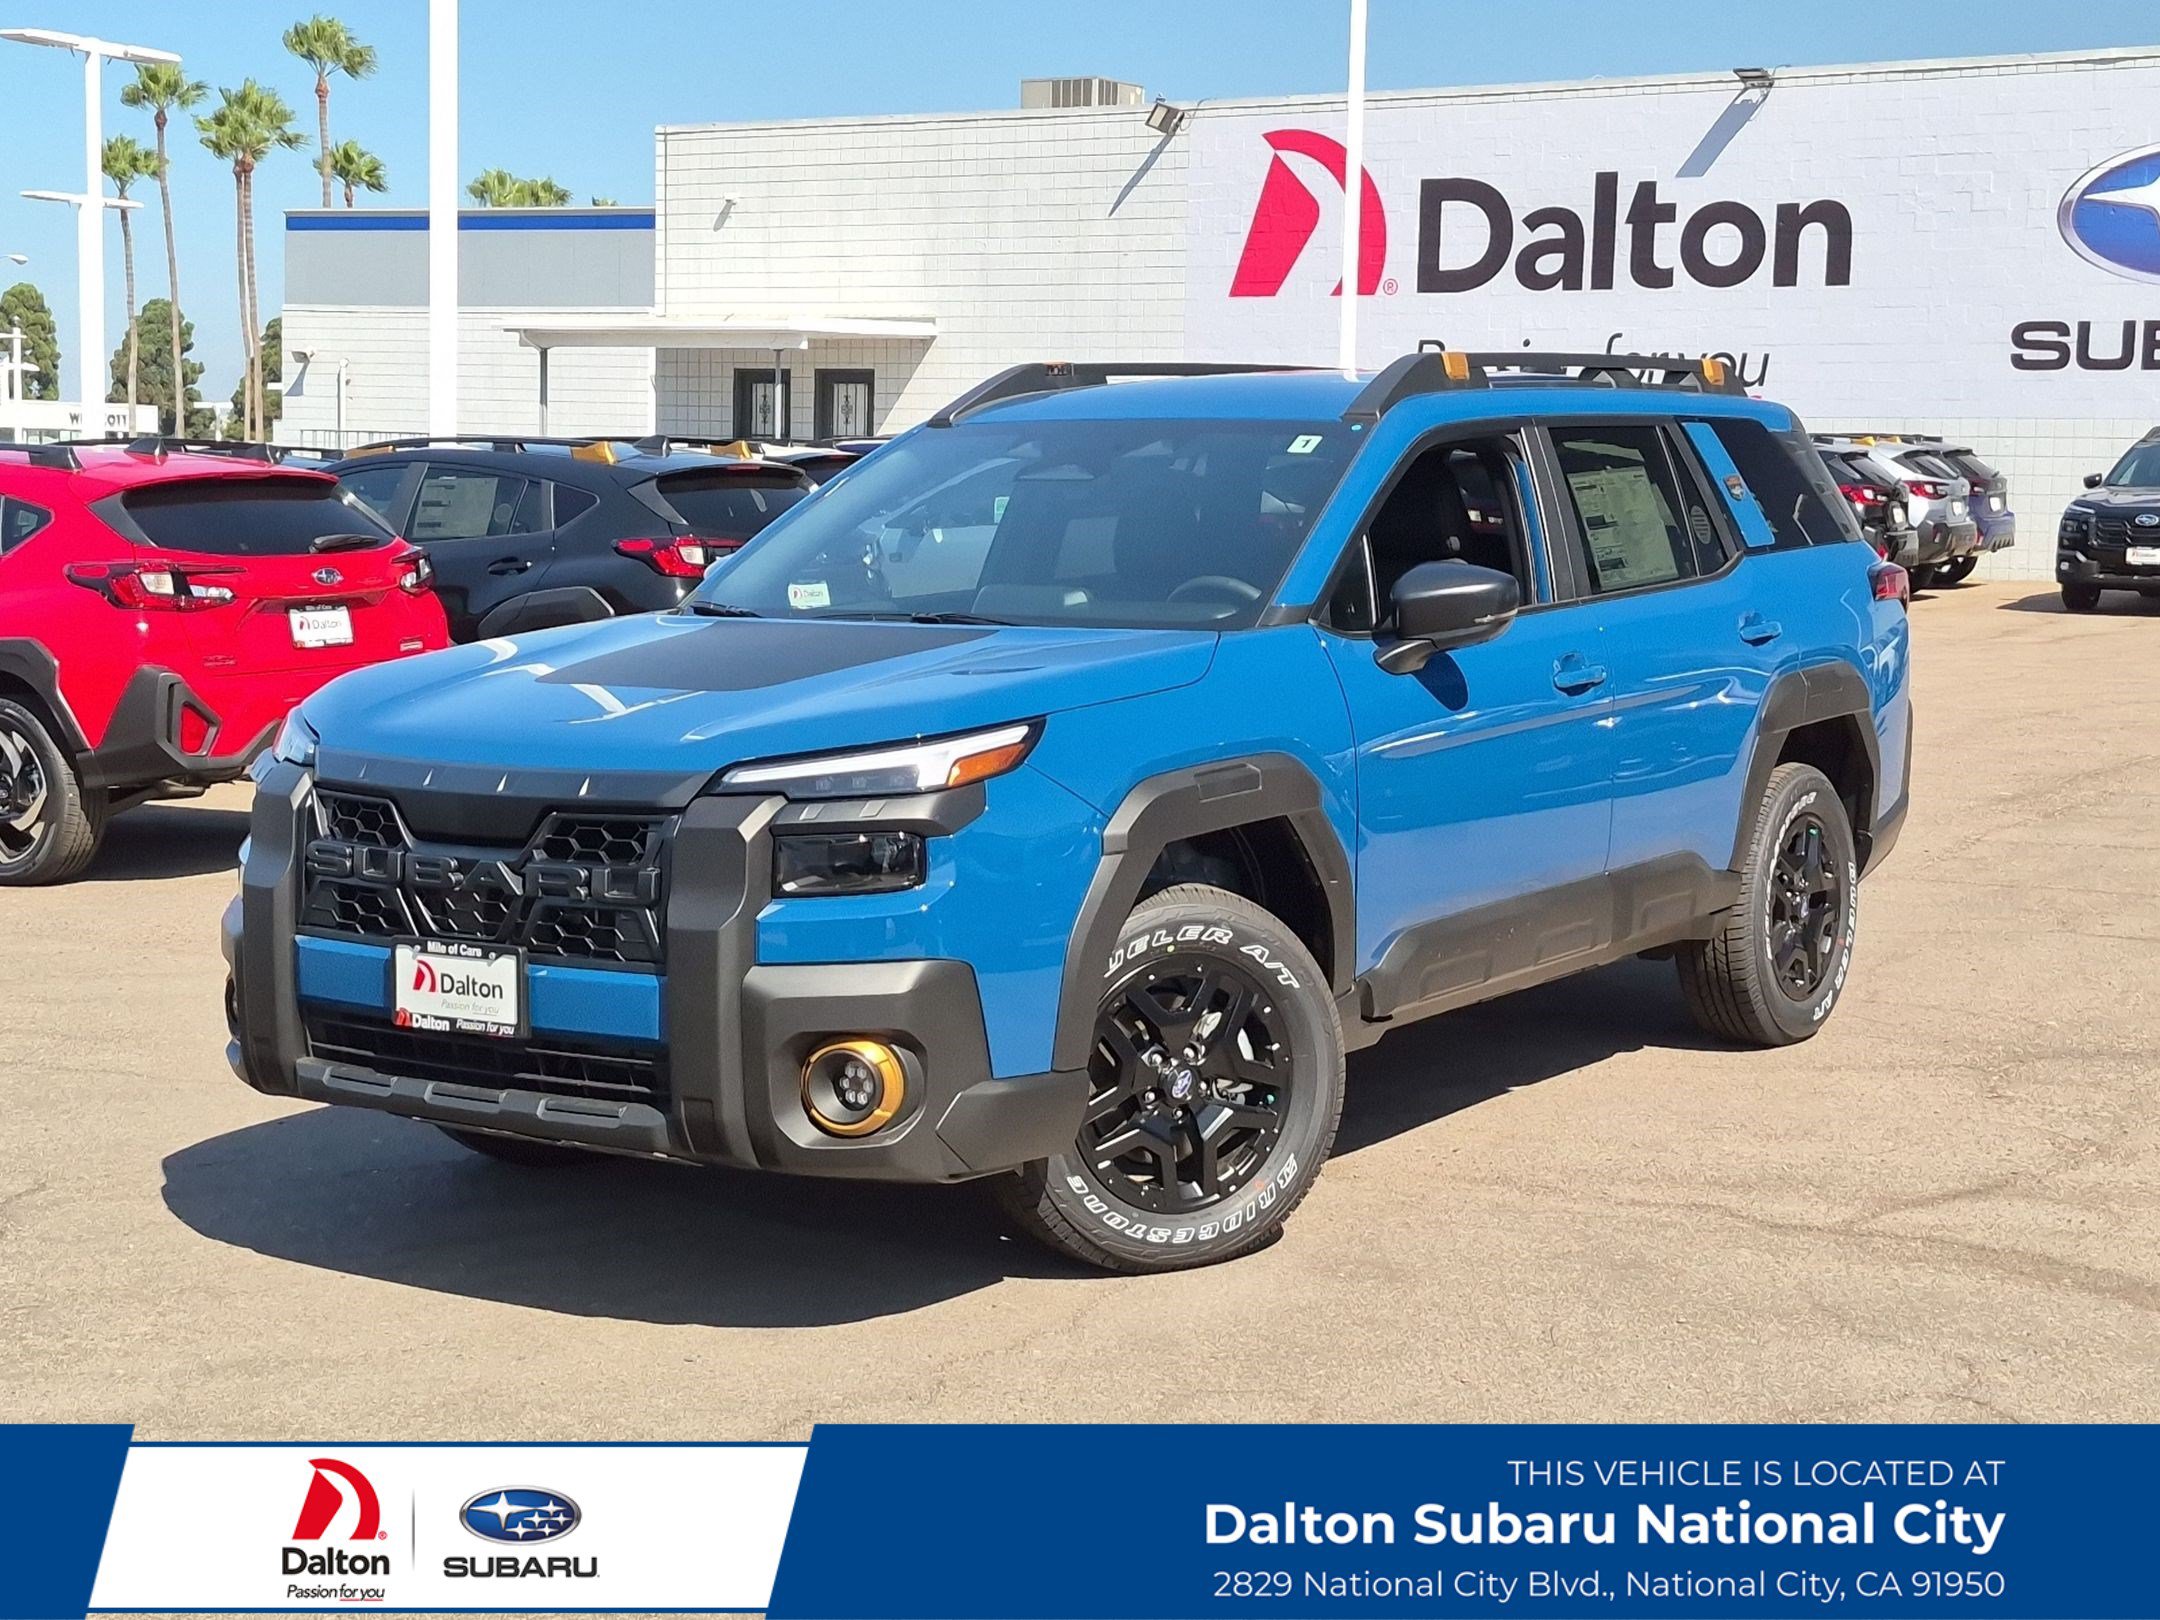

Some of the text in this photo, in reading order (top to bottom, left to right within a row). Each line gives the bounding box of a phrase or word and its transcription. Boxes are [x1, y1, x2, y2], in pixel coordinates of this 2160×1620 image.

[1417, 171, 1853, 294] Dalton
[2010, 319, 2160, 371] SU
[305, 838, 661, 906] SUBARU
[426, 940, 482, 958] Mile of Cars
[1103, 925, 1301, 989] UELER A/T
[440, 972, 504, 1000] Dalton
[412, 1013, 515, 1036] Dalton Passion for you
[1066, 1152, 1299, 1243] BRIDGESTONE
